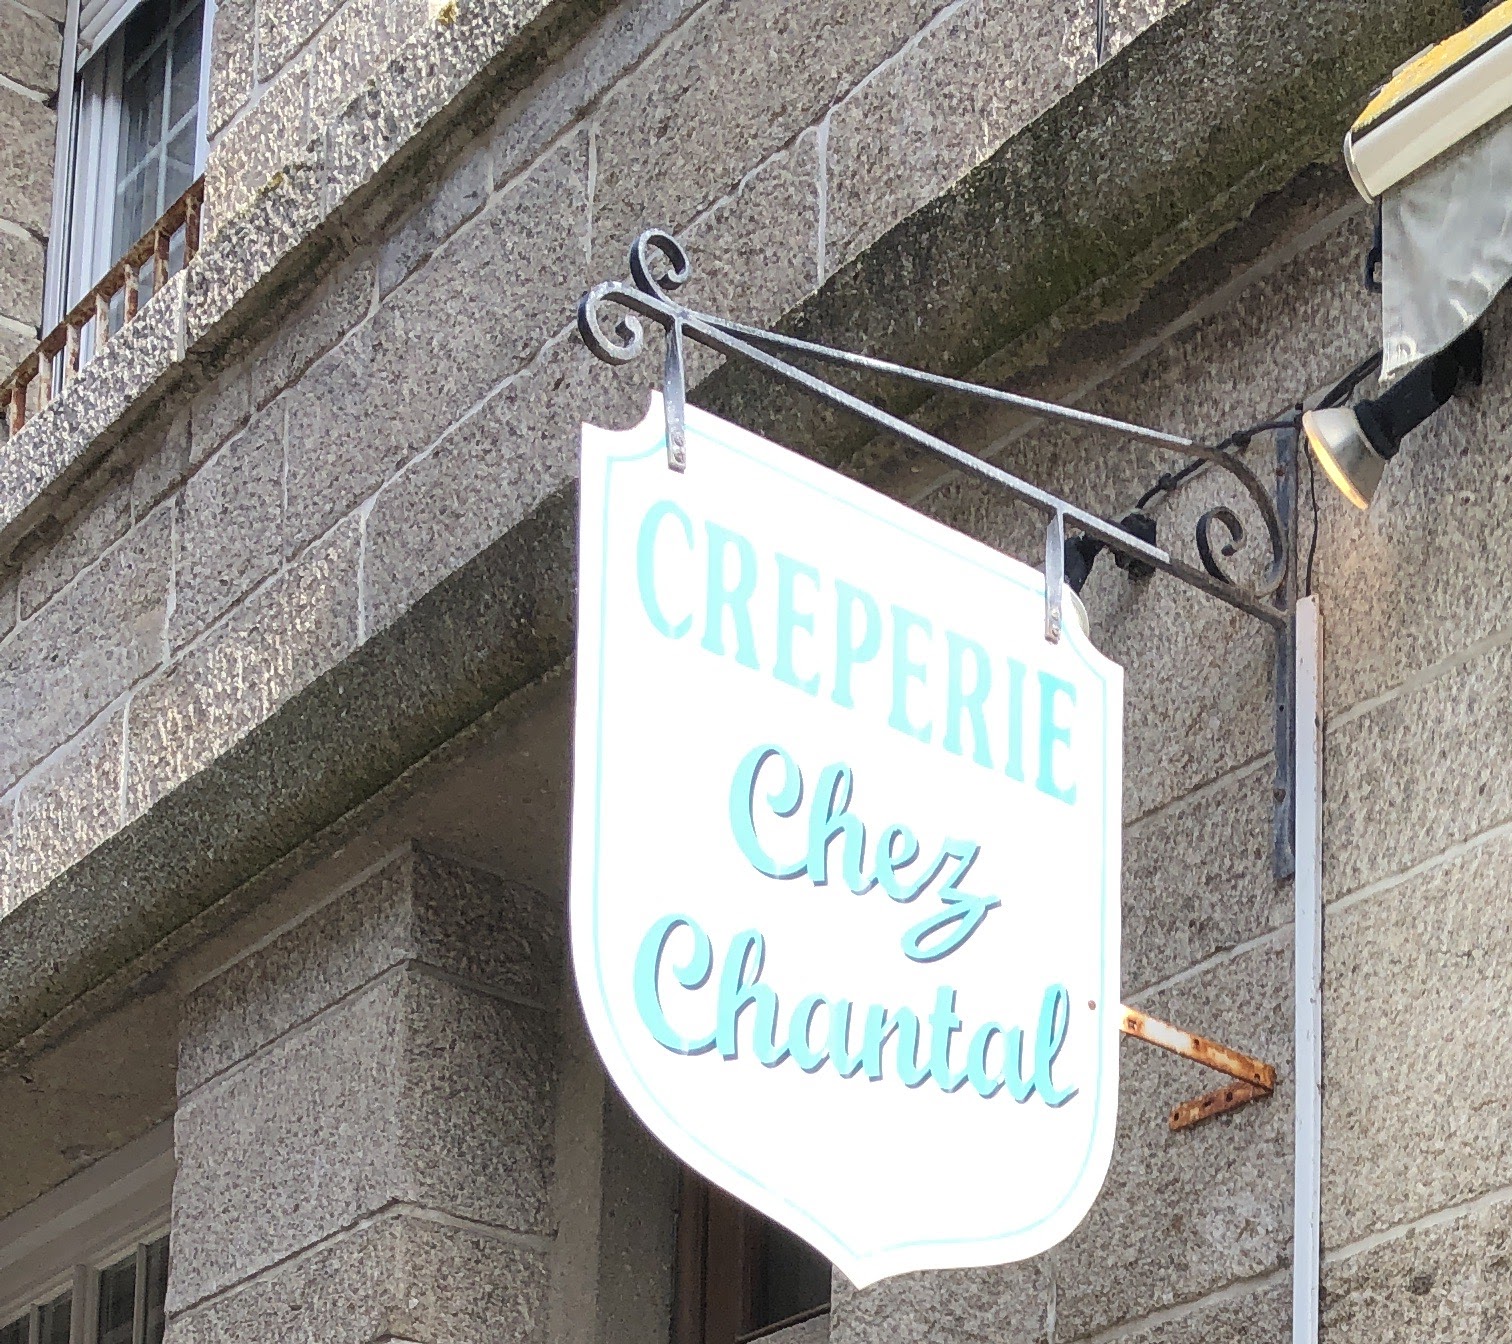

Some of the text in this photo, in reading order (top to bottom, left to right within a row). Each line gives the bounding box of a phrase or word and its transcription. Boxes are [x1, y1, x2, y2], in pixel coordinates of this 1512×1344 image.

[636, 498, 1077, 806] CREPERIE
[728, 742, 1001, 963] Chez
[632, 913, 1079, 1108] Chantal
